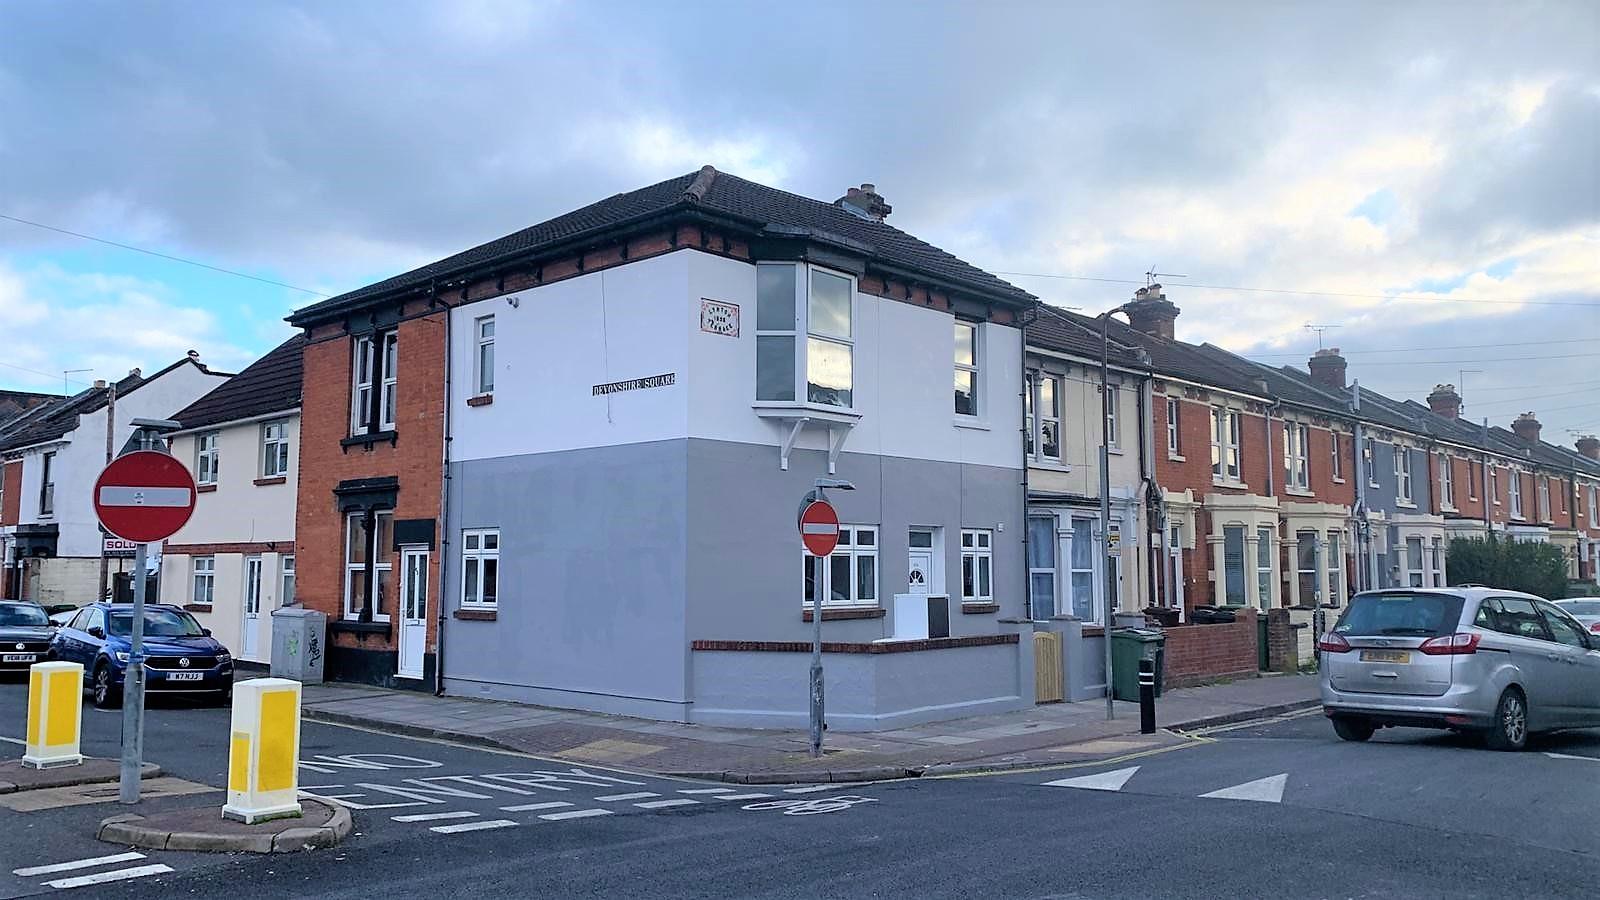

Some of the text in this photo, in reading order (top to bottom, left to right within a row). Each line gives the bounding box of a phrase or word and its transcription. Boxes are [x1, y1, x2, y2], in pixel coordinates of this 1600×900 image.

[593, 374, 675, 395] DEVONSHIRE SQUARE
[298, 753, 443, 773] NO
[298, 769, 646, 809] ENTRY
